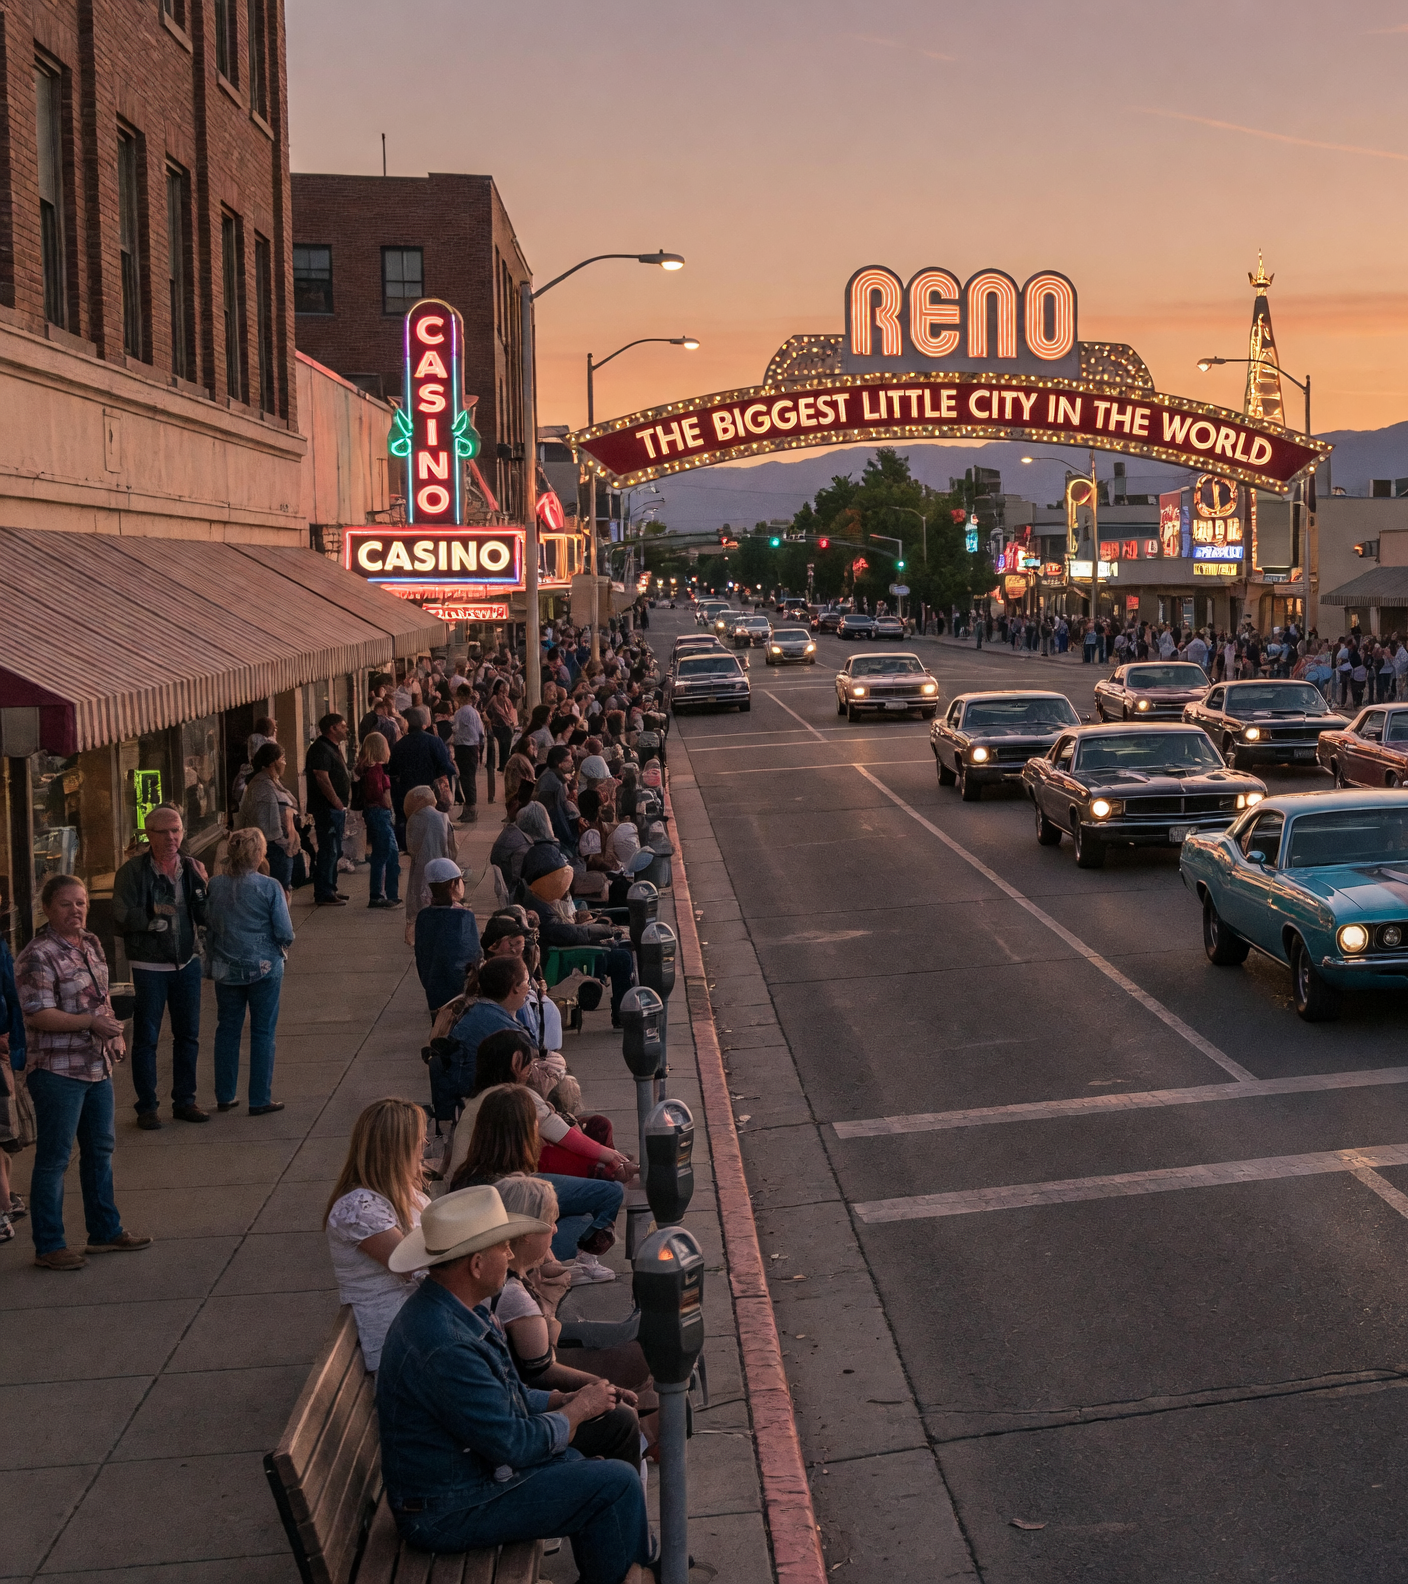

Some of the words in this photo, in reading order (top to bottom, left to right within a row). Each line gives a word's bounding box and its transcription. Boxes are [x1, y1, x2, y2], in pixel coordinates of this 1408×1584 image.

[850, 268, 1075, 361] RENO
[413, 315, 451, 514] CASINO
[635, 416, 704, 459] THE
[711, 393, 850, 442] BIGGEST
[862, 388, 958, 421] LITTLE
[968, 389, 1038, 421] CITY
[1047, 394, 1082, 426] IN
[1093, 400, 1151, 437] THE
[1162, 411, 1273, 466] WORLD
[357, 540, 511, 572] CASINO
